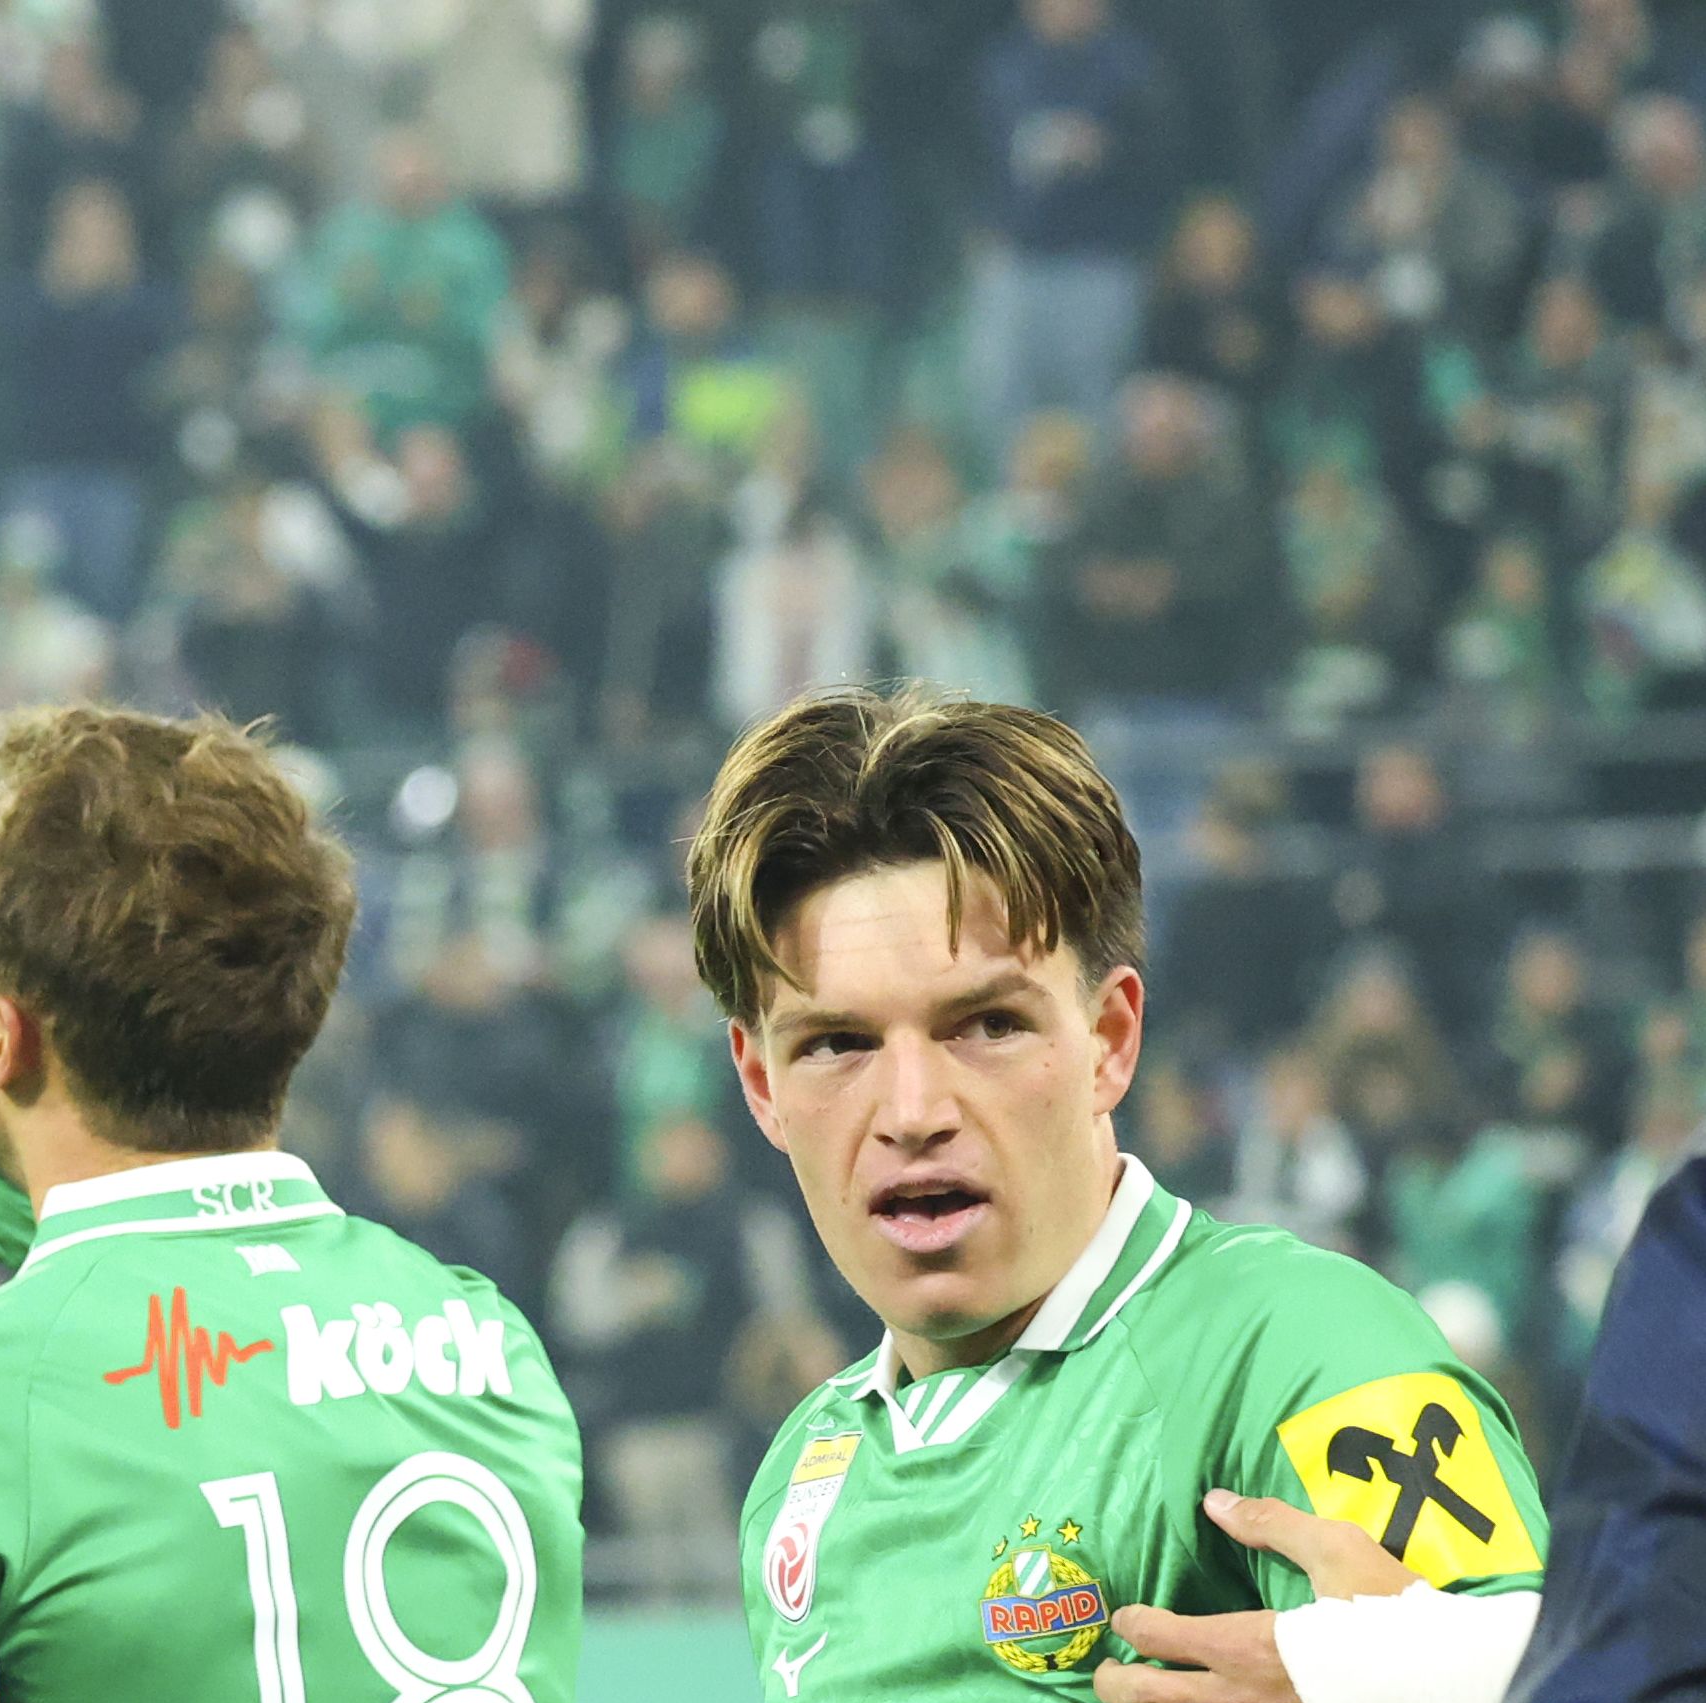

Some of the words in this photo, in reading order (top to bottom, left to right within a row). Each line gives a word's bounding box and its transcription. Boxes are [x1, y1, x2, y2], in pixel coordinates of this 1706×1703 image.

[192, 1179, 281, 1217] SCR
[280, 1298, 513, 1406] köck
[989, 1590, 1098, 1635] RAPID
